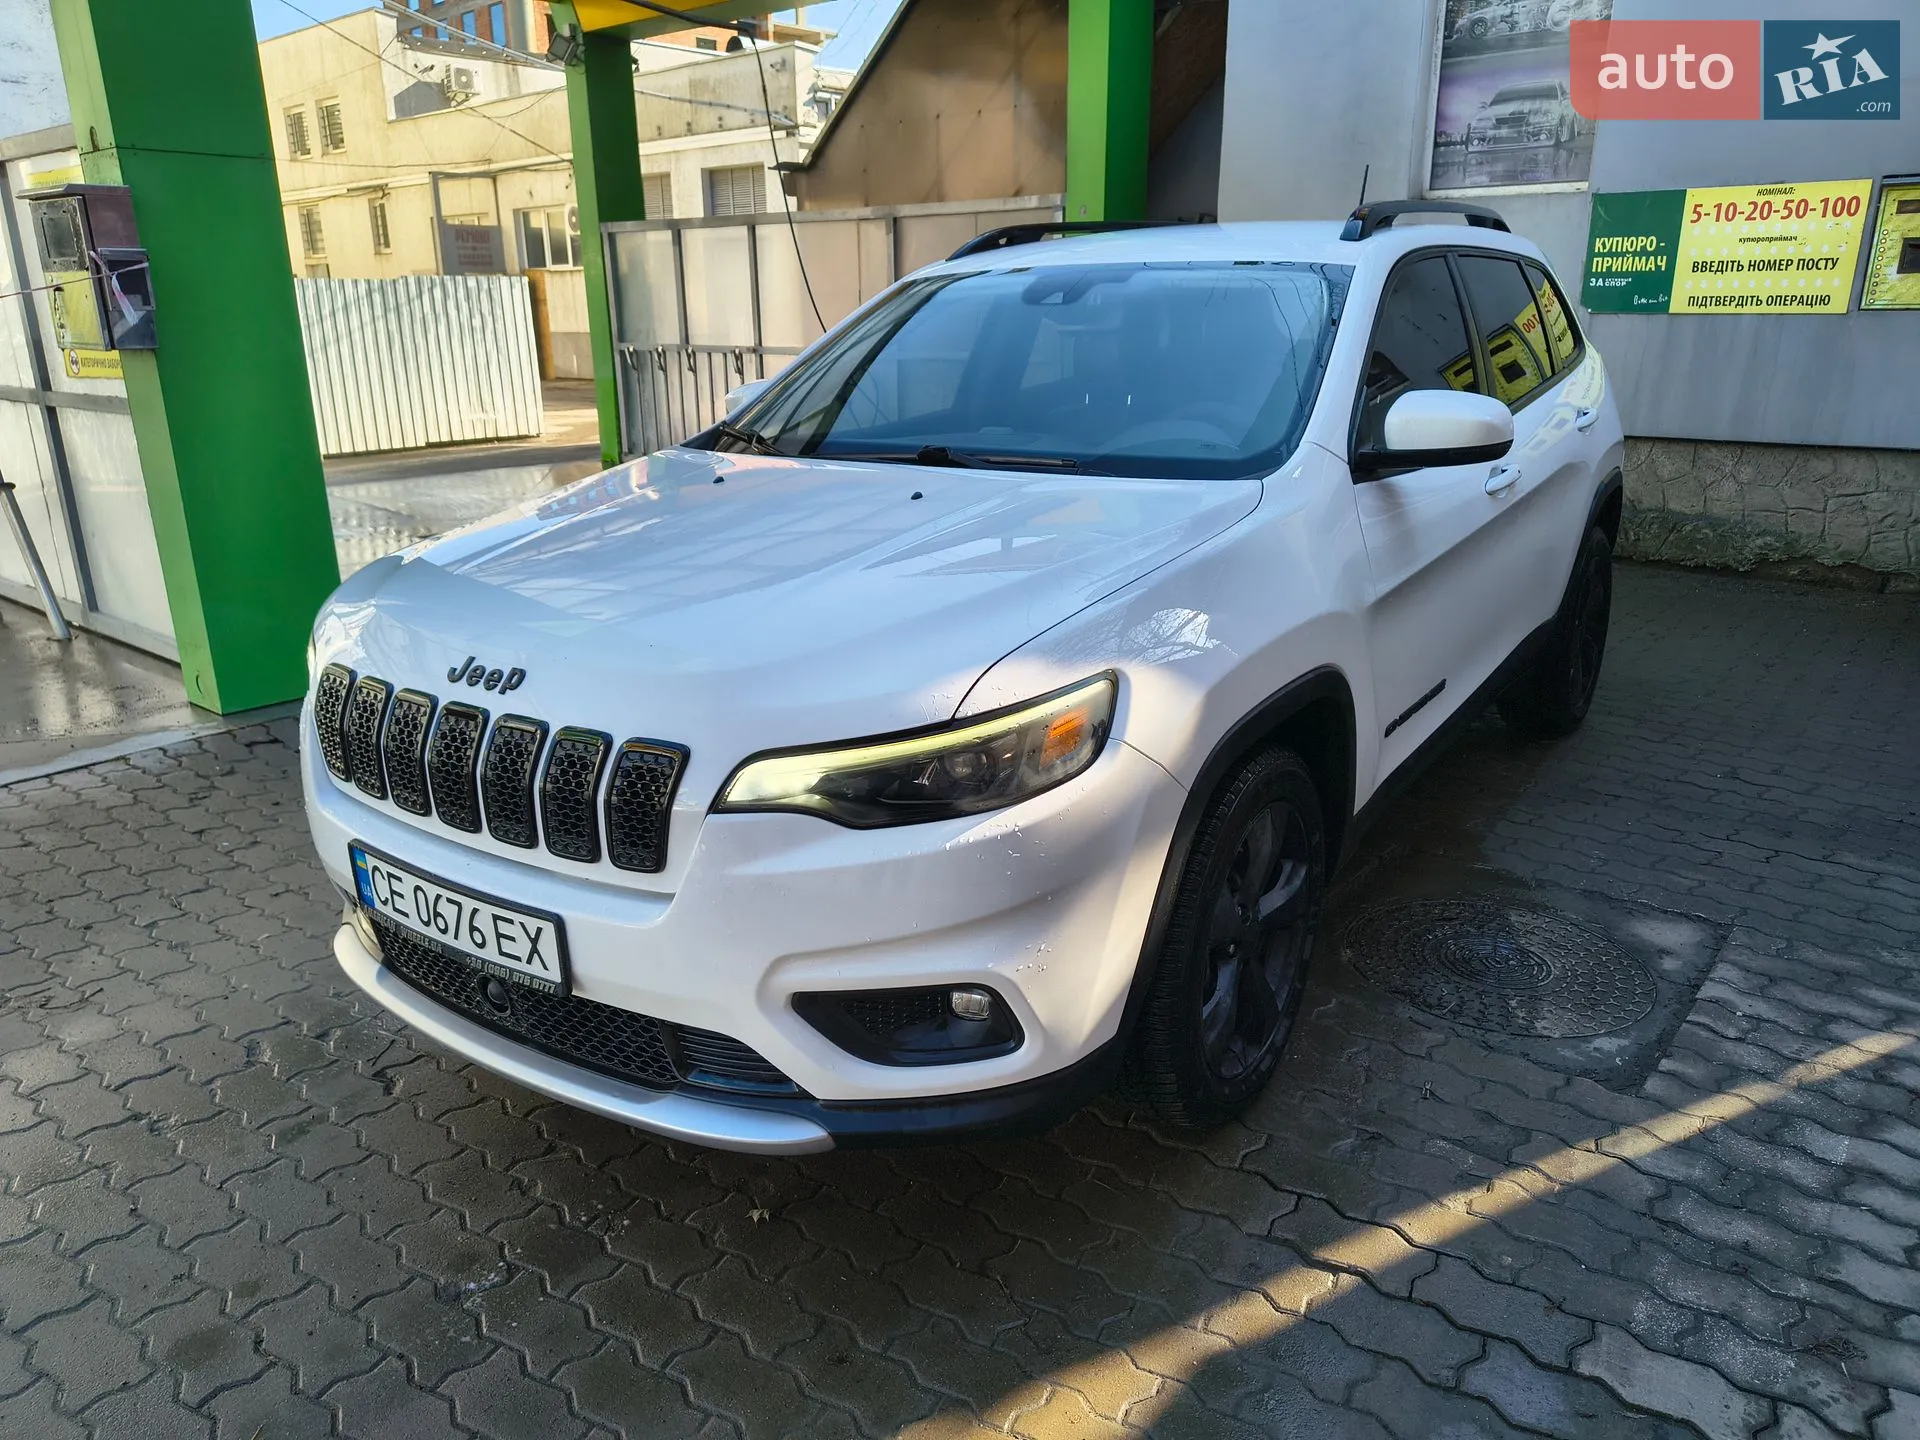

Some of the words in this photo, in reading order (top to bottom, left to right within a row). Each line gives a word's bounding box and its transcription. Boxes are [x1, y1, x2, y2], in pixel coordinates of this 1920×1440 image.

[1756, 187, 1796, 197] НОМІНАЛ:
[1690, 195, 1861, 224] 5-10-20-50-100
[1738, 234, 1798, 244] купюроприймач
[1592, 255, 1667, 273] ПРИЙМАЧ
[1692, 259, 1744, 275] ВВЕДІТЬ
[1747, 258, 1792, 272] НОМЕР
[1796, 257, 1840, 271] ПОСТУ
[1687, 295, 1763, 309] ПІДТВЕРДІТЬ
[1765, 294, 1831, 308] ОПЕРАЦІЮ
[447, 655, 527, 695] Jeep
[361, 883, 373, 899] UA
[413, 884, 487, 950] 0676
